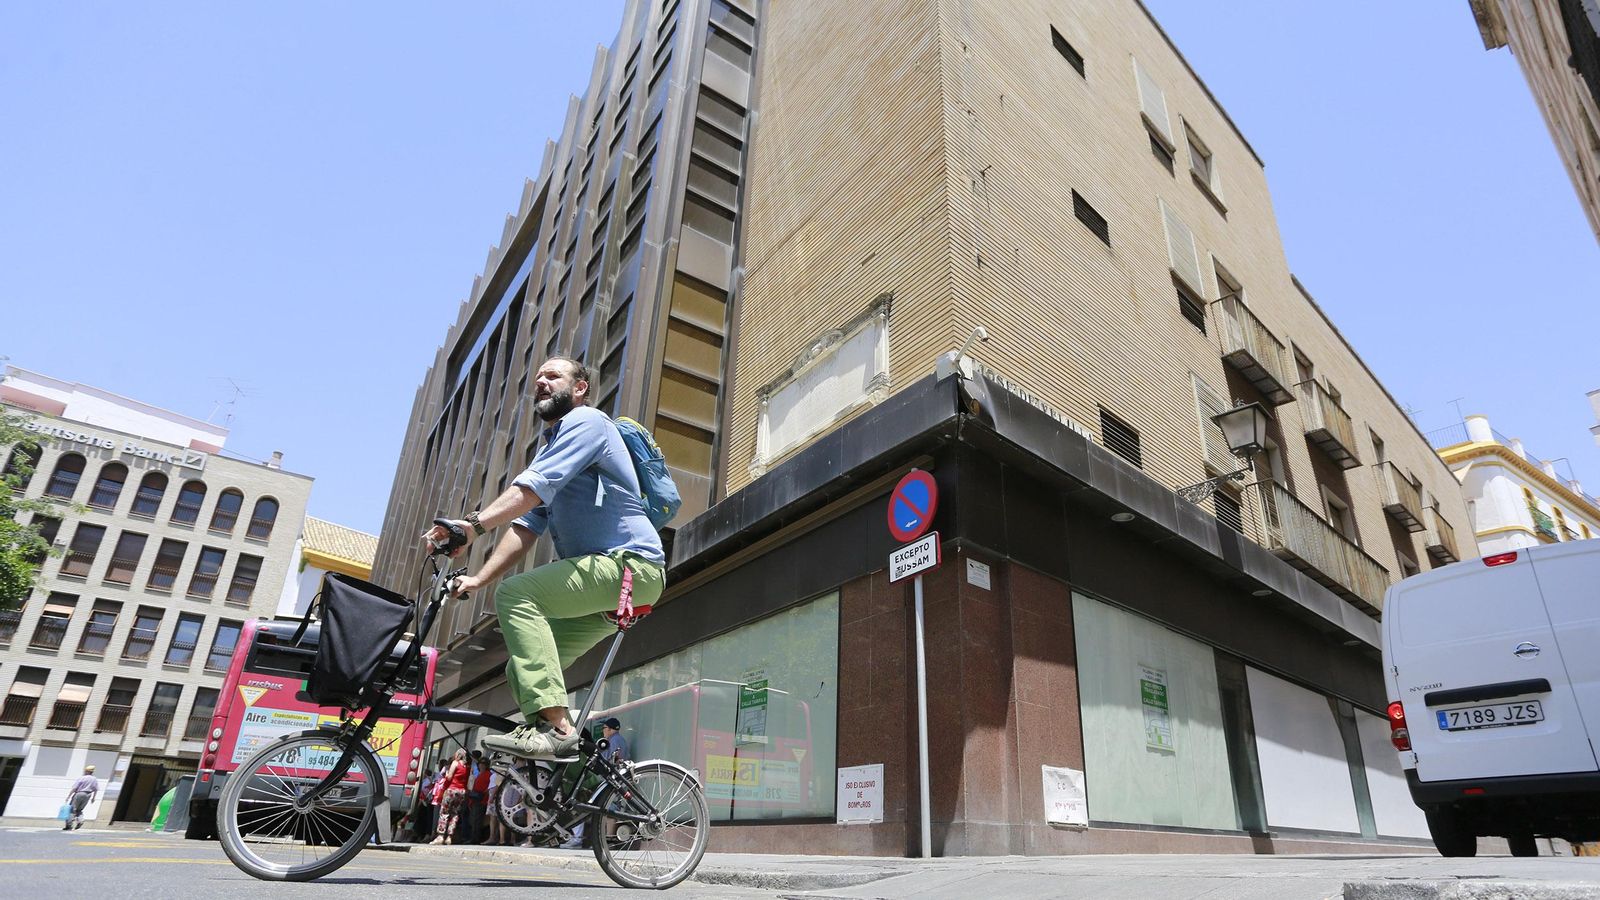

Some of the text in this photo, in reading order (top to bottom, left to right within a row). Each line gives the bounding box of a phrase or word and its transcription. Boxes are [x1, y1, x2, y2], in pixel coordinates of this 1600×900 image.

[120, 441, 174, 464] Bank
[895, 542, 930, 563] EXCEPTO
[246, 712, 267, 723] Aire
[1450, 704, 1538, 726] 7189 JZS
[370, 736, 393, 751] RIA
[308, 757, 316, 765] 95
[317, 756, 334, 766] 484
